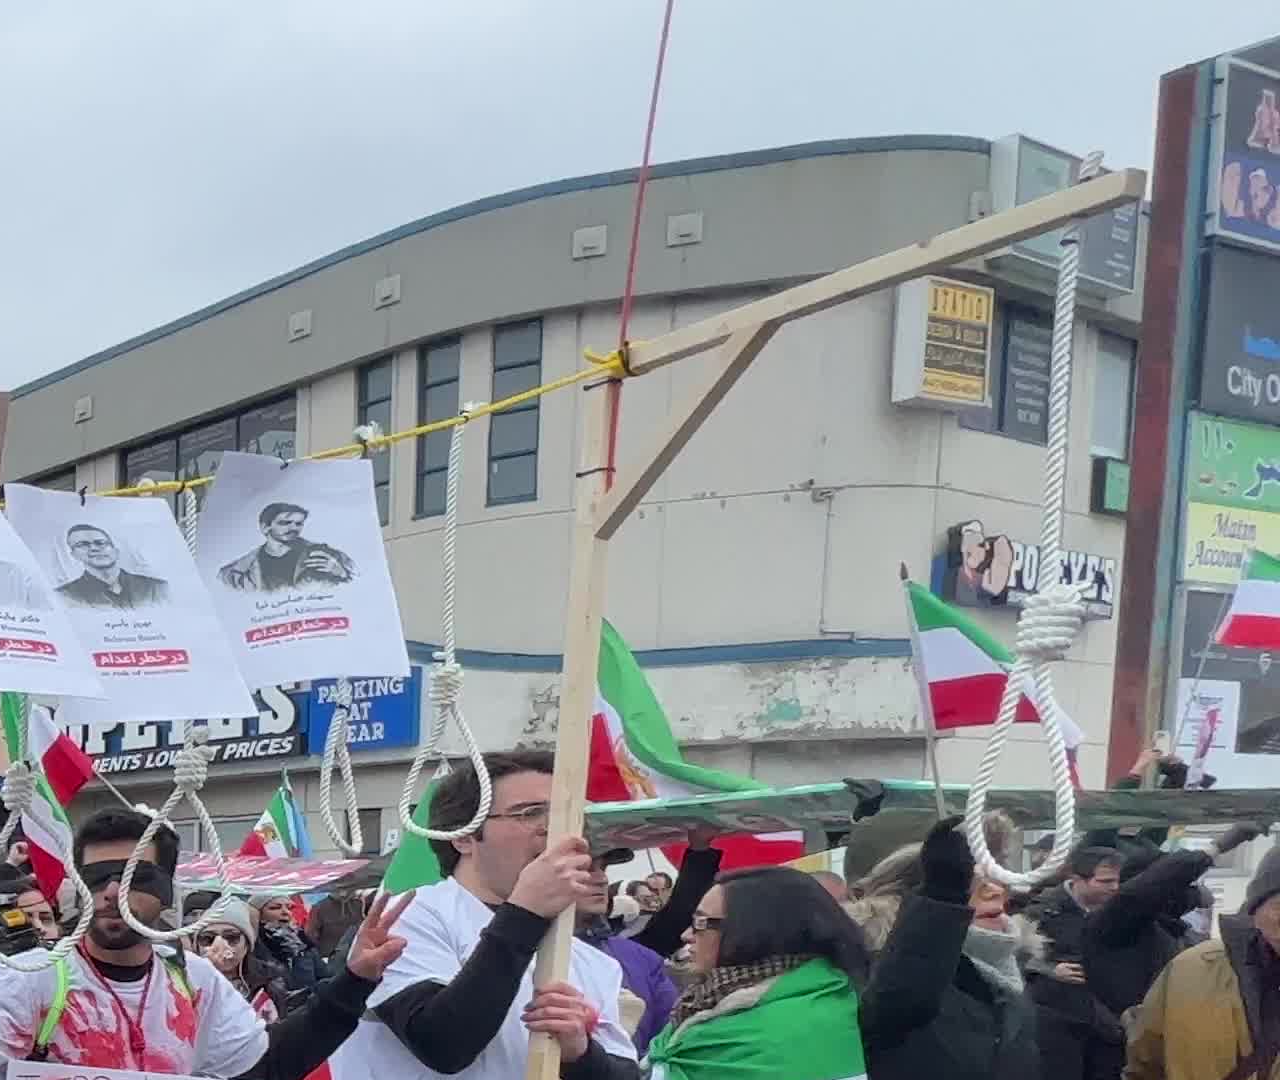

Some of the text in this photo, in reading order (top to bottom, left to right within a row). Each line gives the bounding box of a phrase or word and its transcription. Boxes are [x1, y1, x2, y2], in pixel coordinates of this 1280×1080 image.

[100, 652, 136, 666] اعدام
[138, 651, 169, 666] خطر
[317, 678, 405, 704] PAKING
[345, 722, 385, 744] EAR
[223, 735, 296, 762] PRICES
